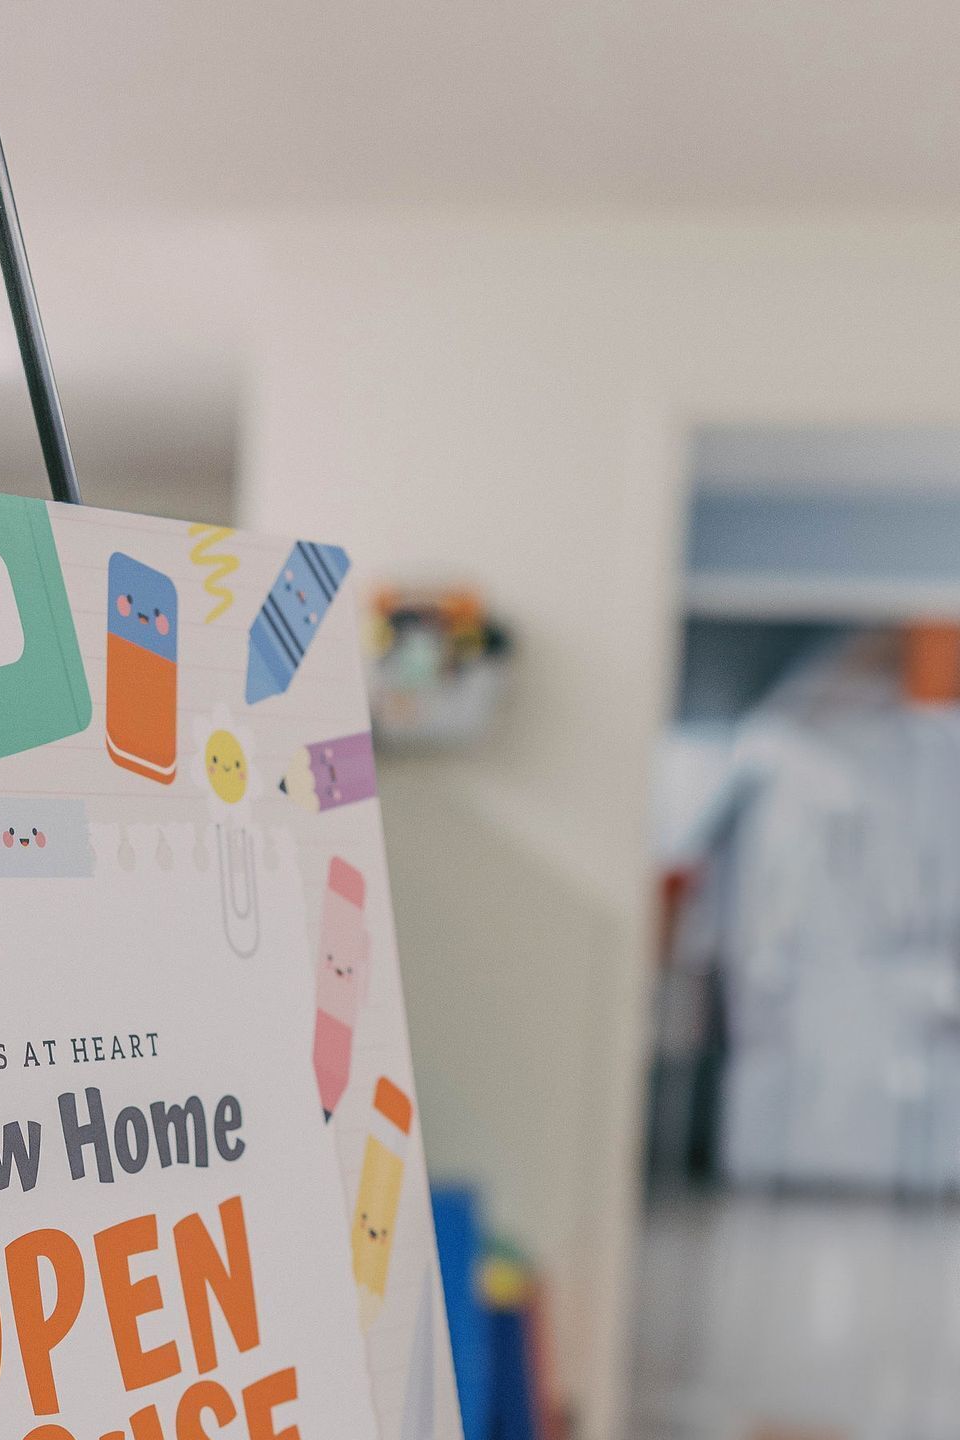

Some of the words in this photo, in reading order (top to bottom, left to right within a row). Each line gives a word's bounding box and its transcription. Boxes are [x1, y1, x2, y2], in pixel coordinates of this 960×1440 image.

[24, 1040, 57, 1067] AT
[71, 1033, 159, 1063] HEART
[58, 1087, 246, 1183] Home
